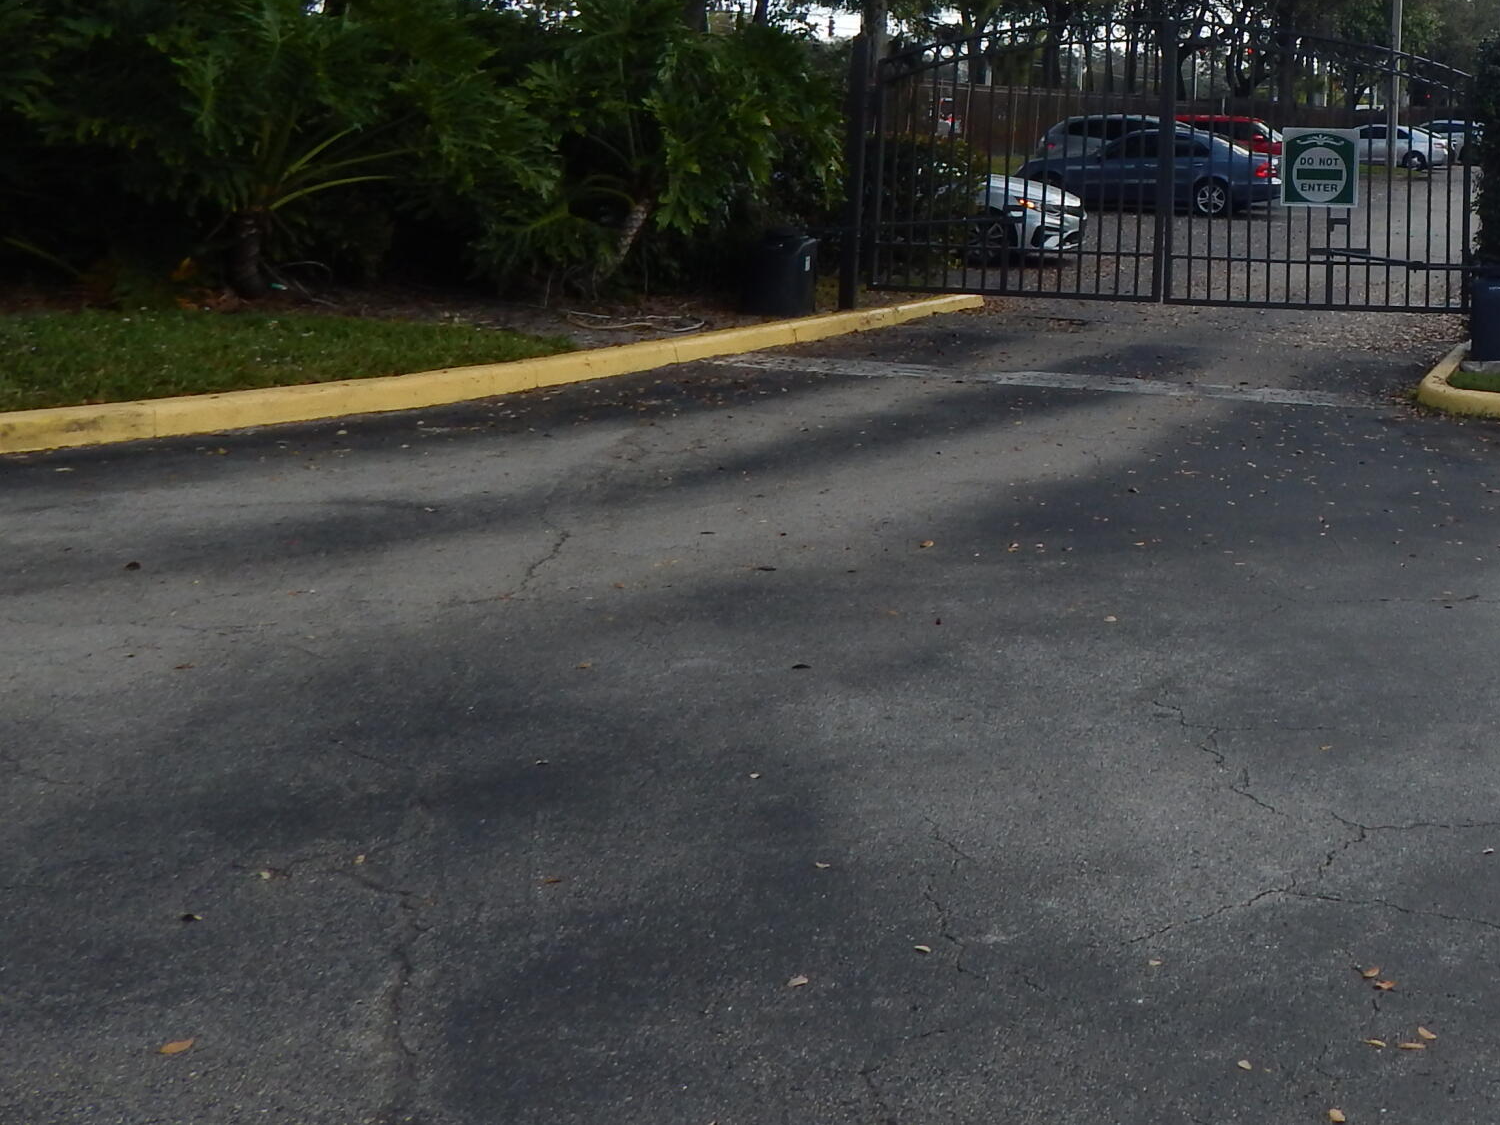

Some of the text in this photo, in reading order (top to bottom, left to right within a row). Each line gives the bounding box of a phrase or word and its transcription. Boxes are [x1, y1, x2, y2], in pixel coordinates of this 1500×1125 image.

[1300, 157, 1340, 166] DO NOT
[1300, 183, 1338, 192] ENTER
